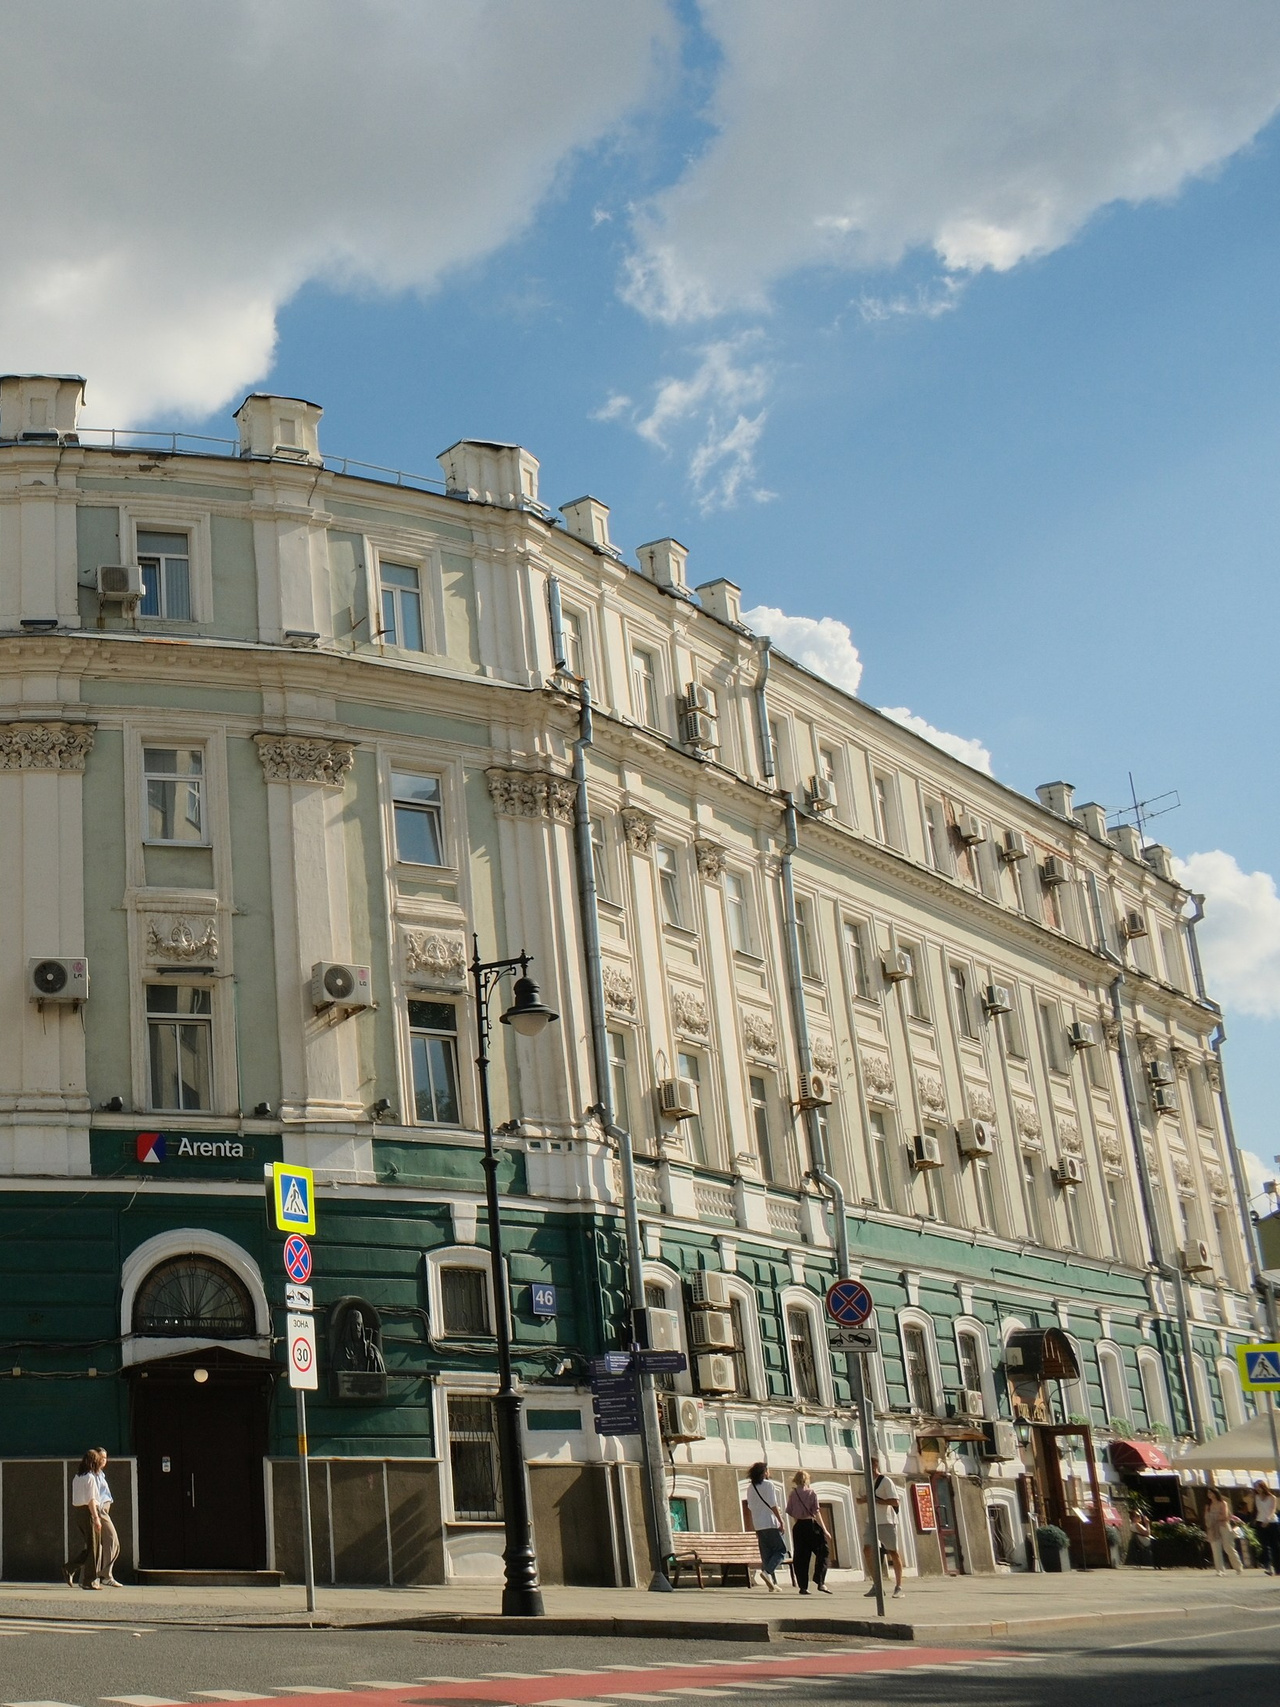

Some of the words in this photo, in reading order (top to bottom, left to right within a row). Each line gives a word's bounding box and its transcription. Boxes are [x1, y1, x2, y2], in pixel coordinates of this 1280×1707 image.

[177, 1137, 244, 1158] Arenta
[535, 1289, 553, 1306] 46
[293, 1319, 309, 1329] ЗОНА
[296, 1347, 309, 1362] 30
